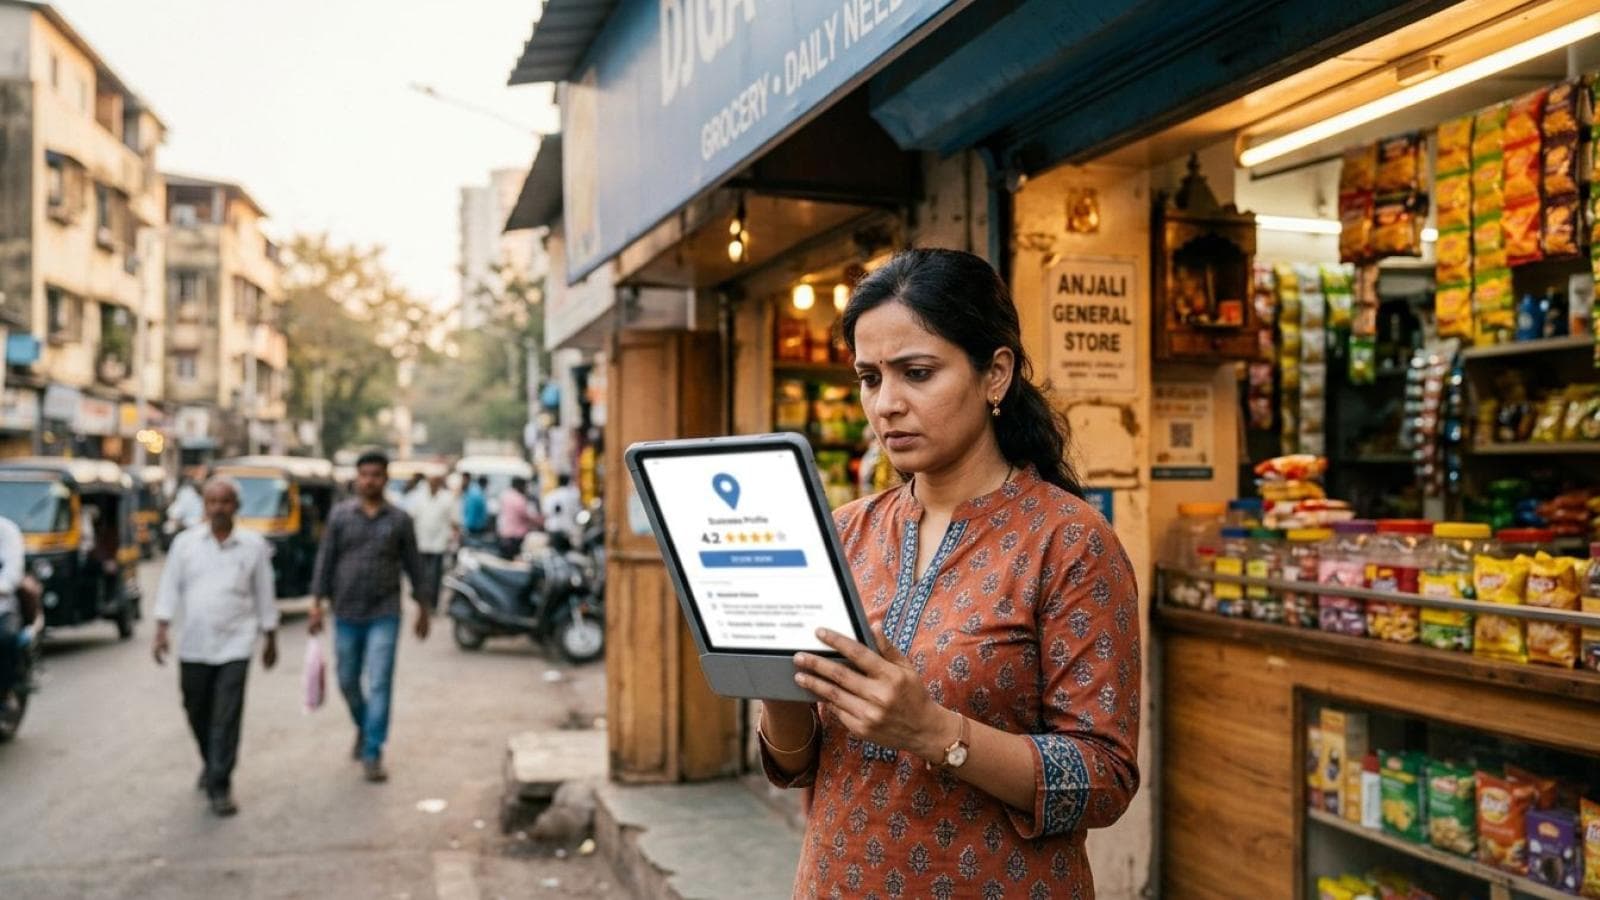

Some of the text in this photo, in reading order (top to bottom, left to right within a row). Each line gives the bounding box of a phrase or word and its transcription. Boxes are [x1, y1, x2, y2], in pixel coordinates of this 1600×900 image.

[701, 72, 770, 161] GROCERY
[785, 10, 839, 97] DAILY
[1057, 273, 1127, 297] ANJALI
[1052, 304, 1132, 325] GENERAL
[1064, 332, 1121, 352] STORE
